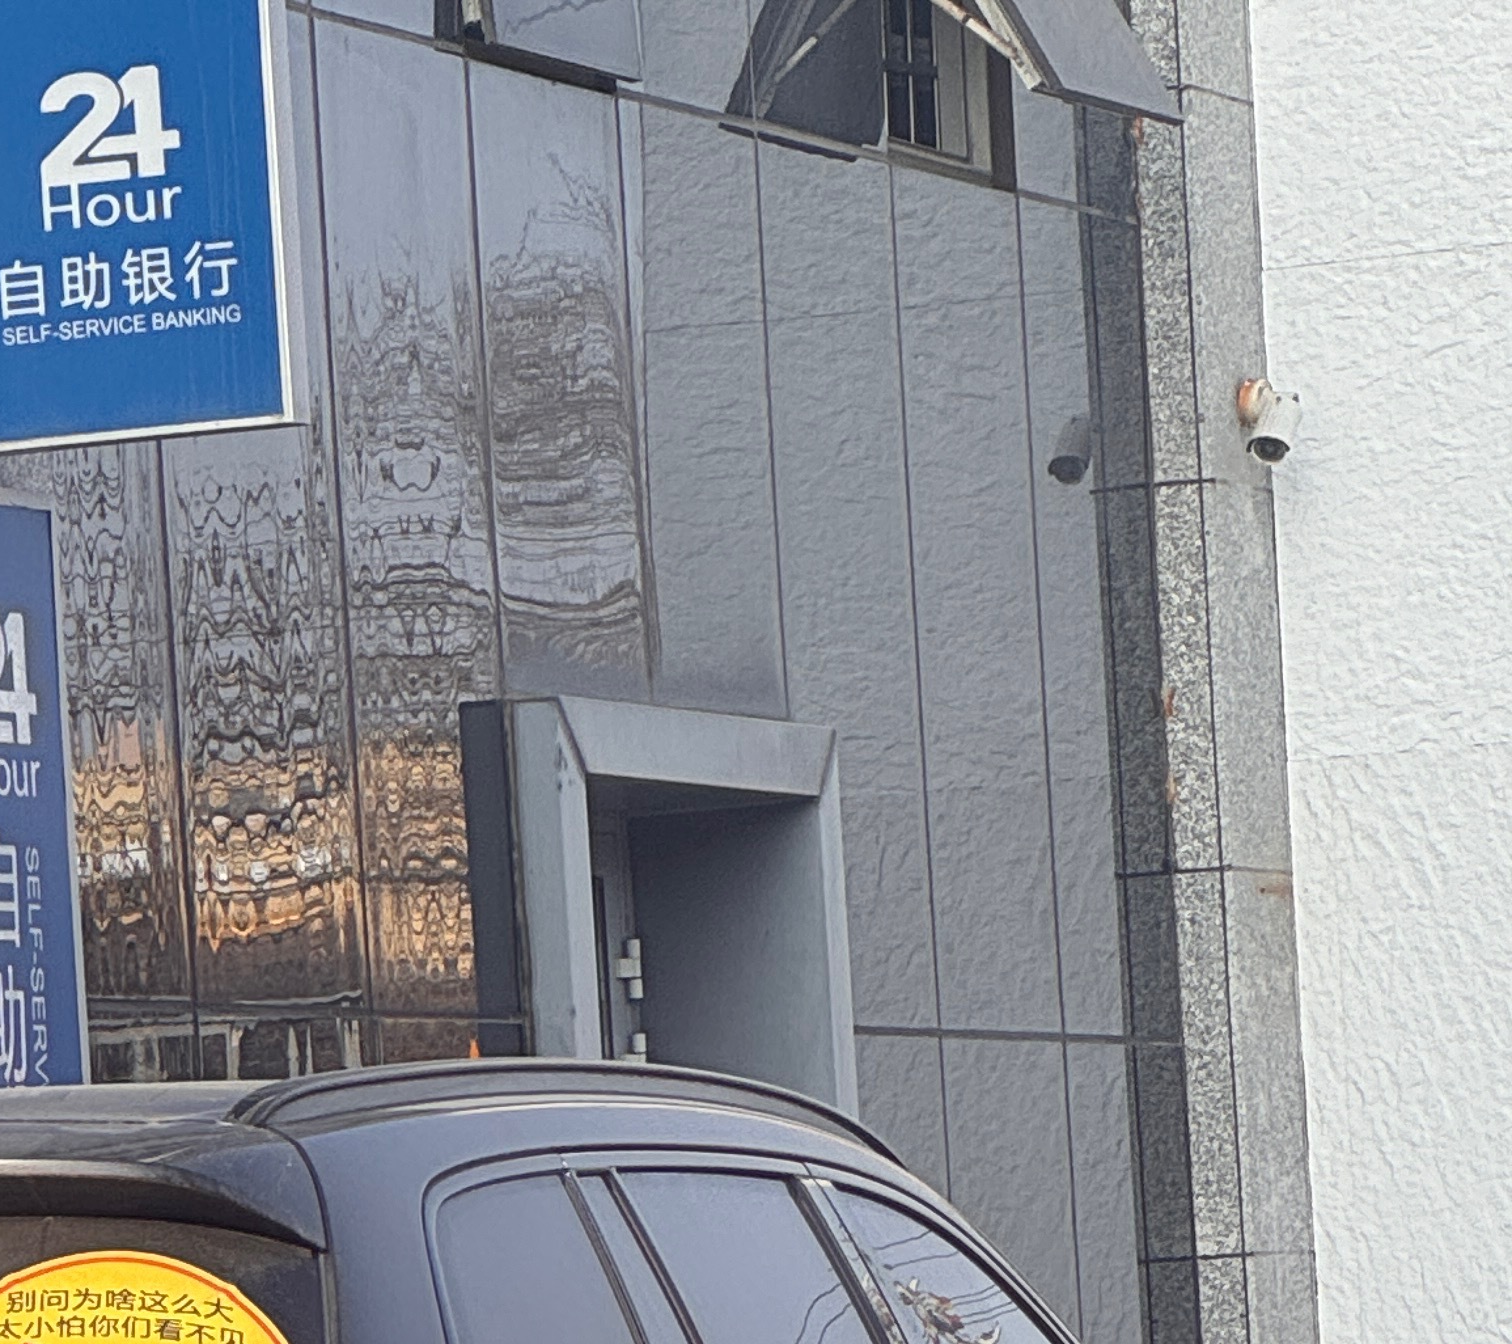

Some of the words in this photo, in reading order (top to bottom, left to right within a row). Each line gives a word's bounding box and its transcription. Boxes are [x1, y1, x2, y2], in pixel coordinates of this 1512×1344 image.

[38, 64, 181, 186] 24
[41, 180, 182, 232] Hour
[2, 314, 146, 347] SELF-SERVICE
[152, 303, 242, 331] BANKING
[6, 1288, 234, 1323] 别问为啥这么大
